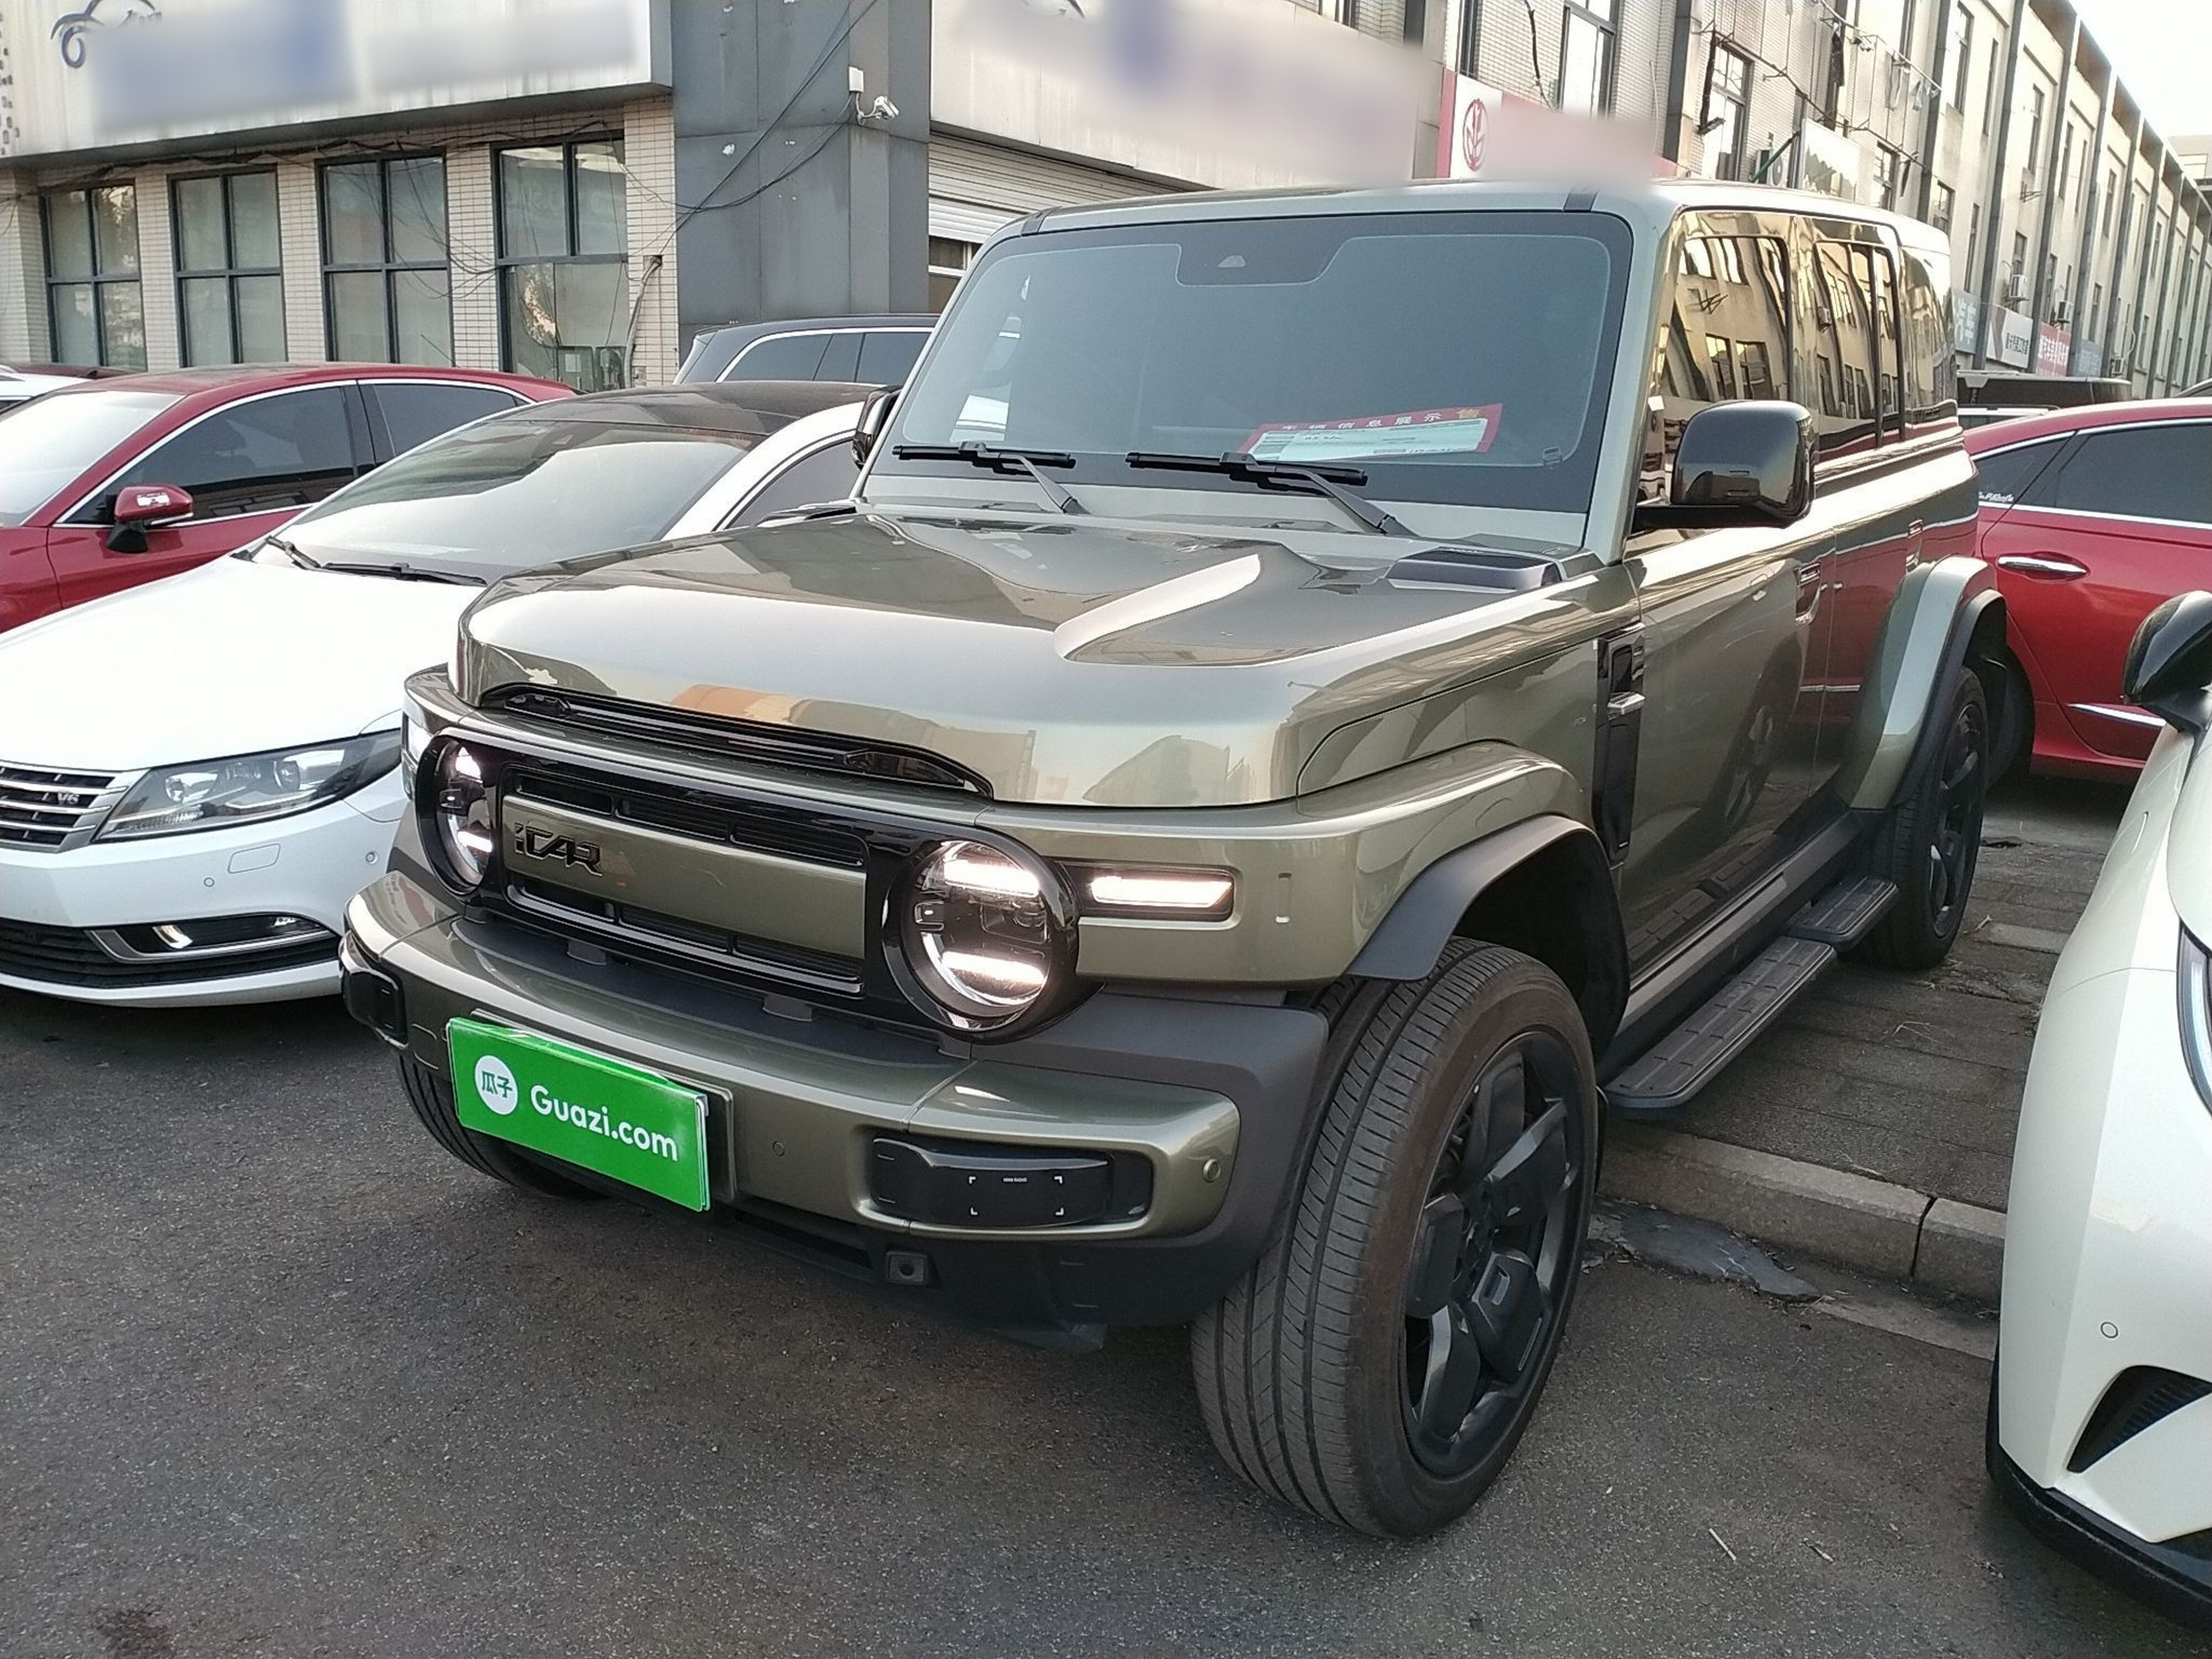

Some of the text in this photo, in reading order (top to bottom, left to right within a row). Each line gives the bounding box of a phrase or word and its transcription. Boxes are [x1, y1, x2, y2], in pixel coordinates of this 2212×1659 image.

[58, 793, 79, 805] V6
[482, 1070, 513, 1098] 瓜子
[531, 1085, 678, 1162] Guazi.com
